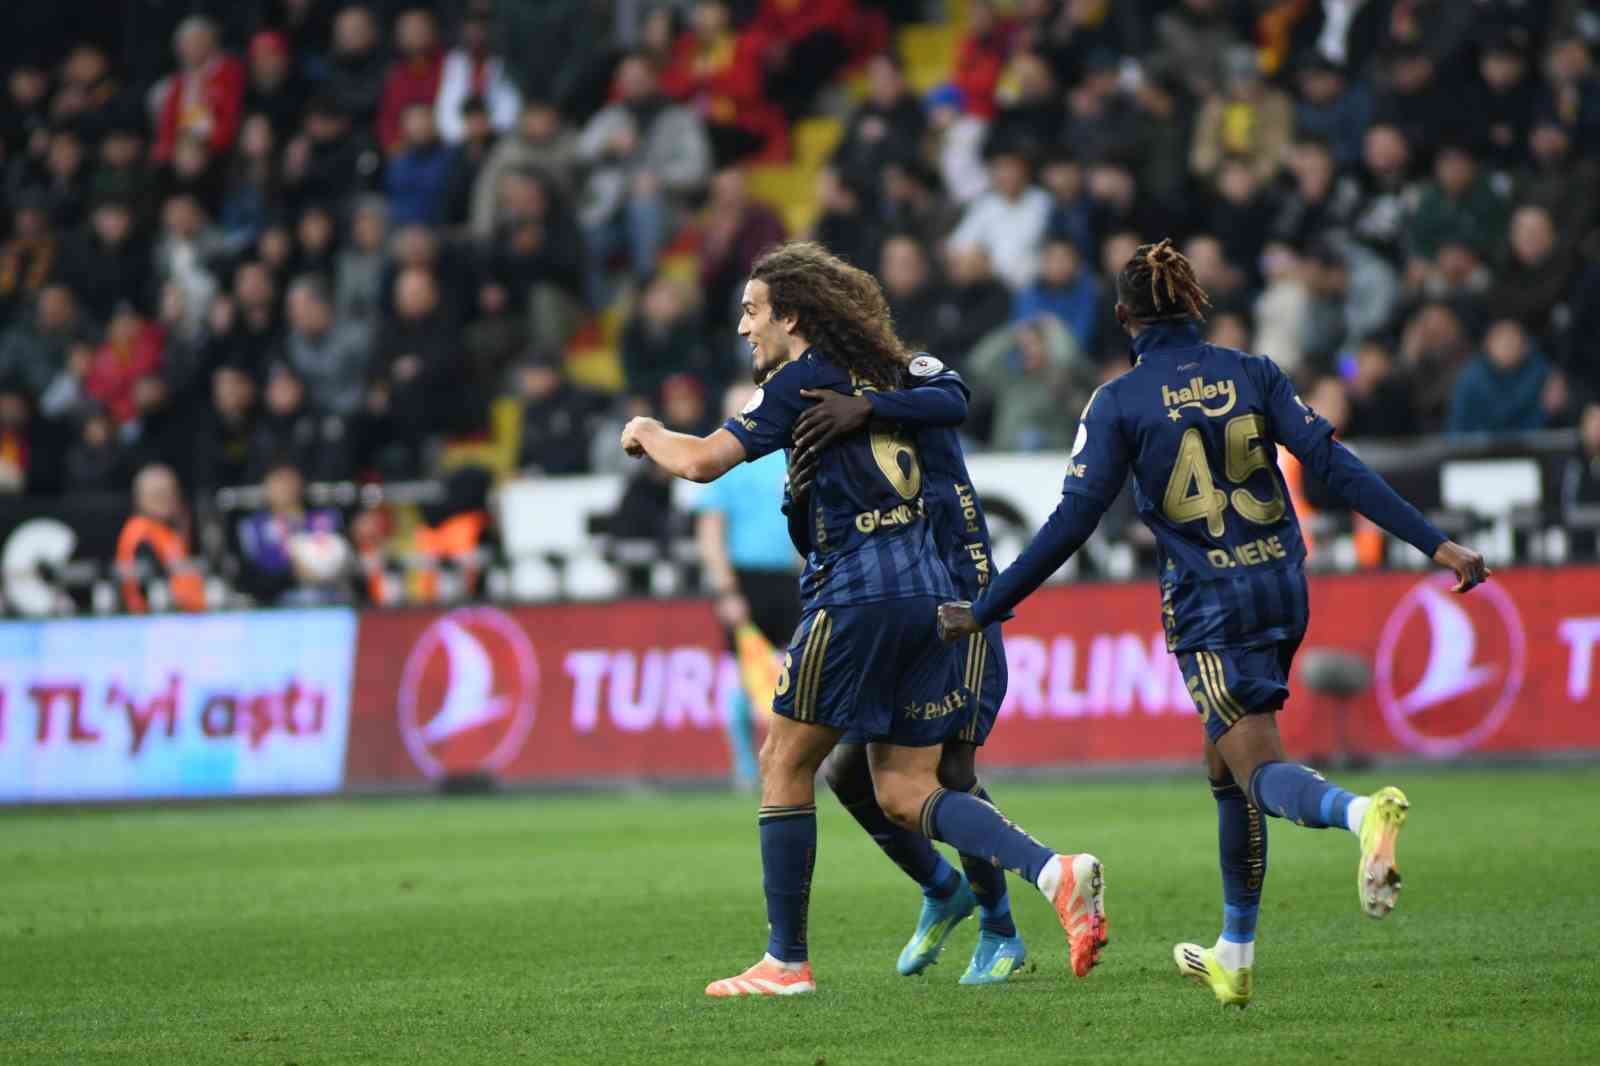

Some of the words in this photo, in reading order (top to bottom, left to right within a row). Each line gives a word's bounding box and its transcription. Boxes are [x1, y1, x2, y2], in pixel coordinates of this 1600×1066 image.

[1162, 377, 1237, 417] halley
[869, 432, 921, 500] 6
[1162, 413, 1285, 538] 45
[953, 482, 979, 533] PORT
